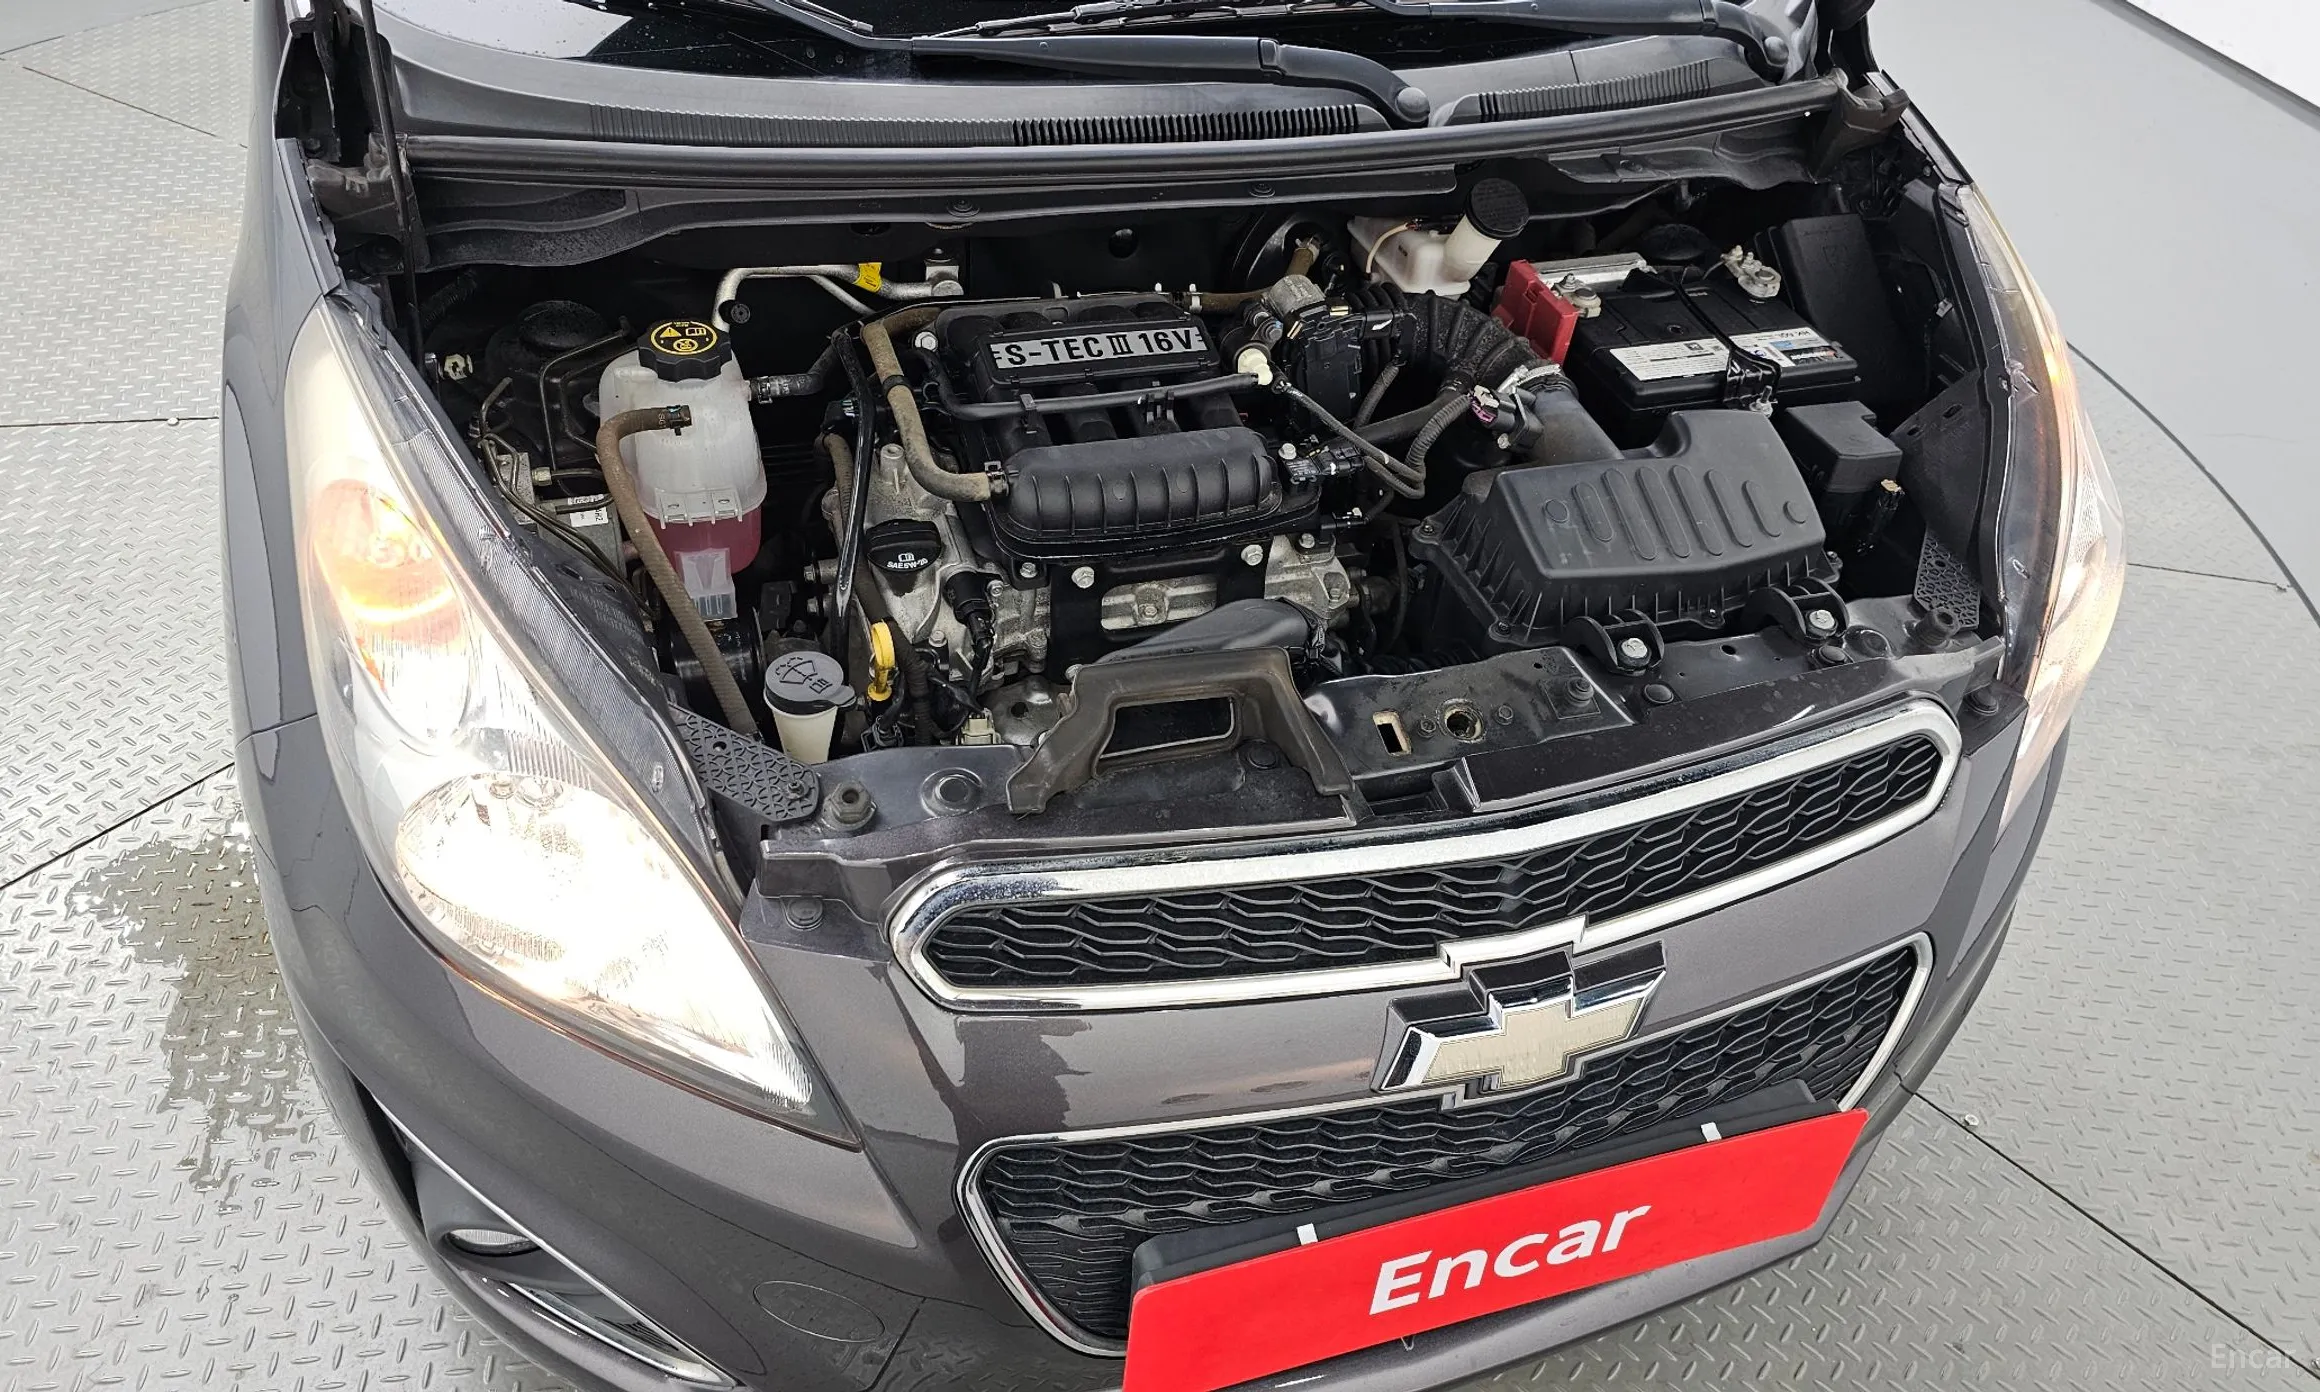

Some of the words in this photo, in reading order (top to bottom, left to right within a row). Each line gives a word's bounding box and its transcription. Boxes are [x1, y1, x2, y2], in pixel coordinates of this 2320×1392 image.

[1007, 336, 1103, 366] S-TEC
[1138, 330, 1193, 353] 16V
[1369, 1205, 1652, 1315] Encar
